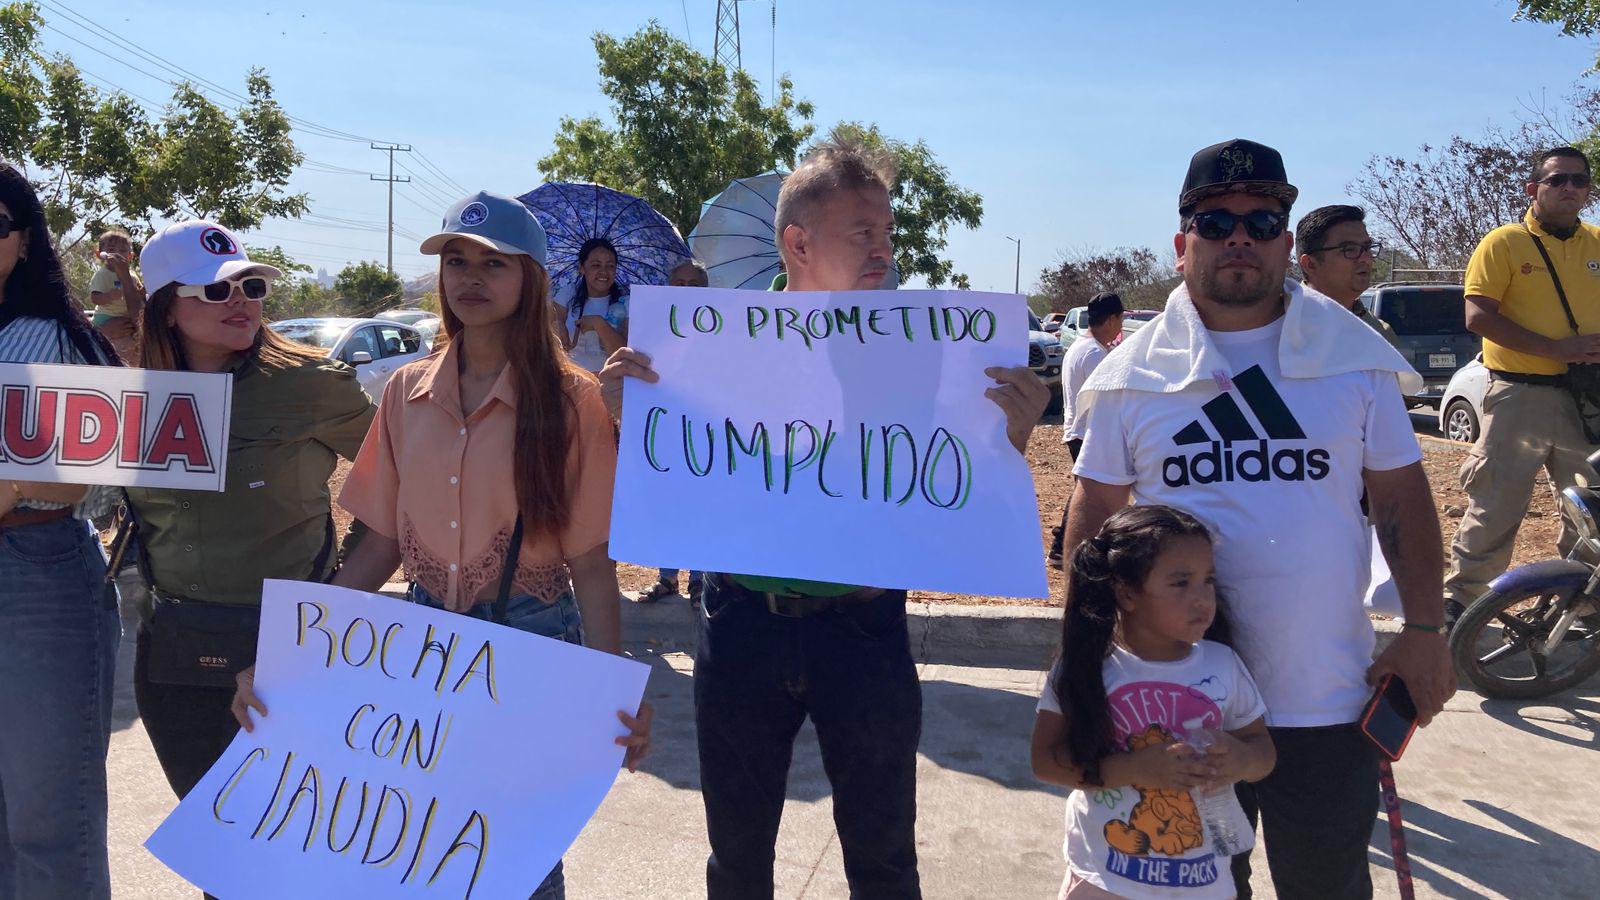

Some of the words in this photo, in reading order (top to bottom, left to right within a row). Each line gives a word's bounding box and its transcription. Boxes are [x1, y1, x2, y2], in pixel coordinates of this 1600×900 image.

[669, 304, 723, 338] LO
[747, 304, 997, 350] PROMETIDO
[0, 384, 215, 473] UDIA
[643, 406, 972, 510] CUMPLIDO
[1162, 438, 1330, 488] adidas
[297, 601, 498, 703] ROCHA
[344, 703, 454, 772] CON
[1109, 688, 1182, 734] UTEST
[1111, 850, 1129, 875] IN
[1138, 858, 1171, 883] THE
[1180, 859, 1217, 884] PACK
